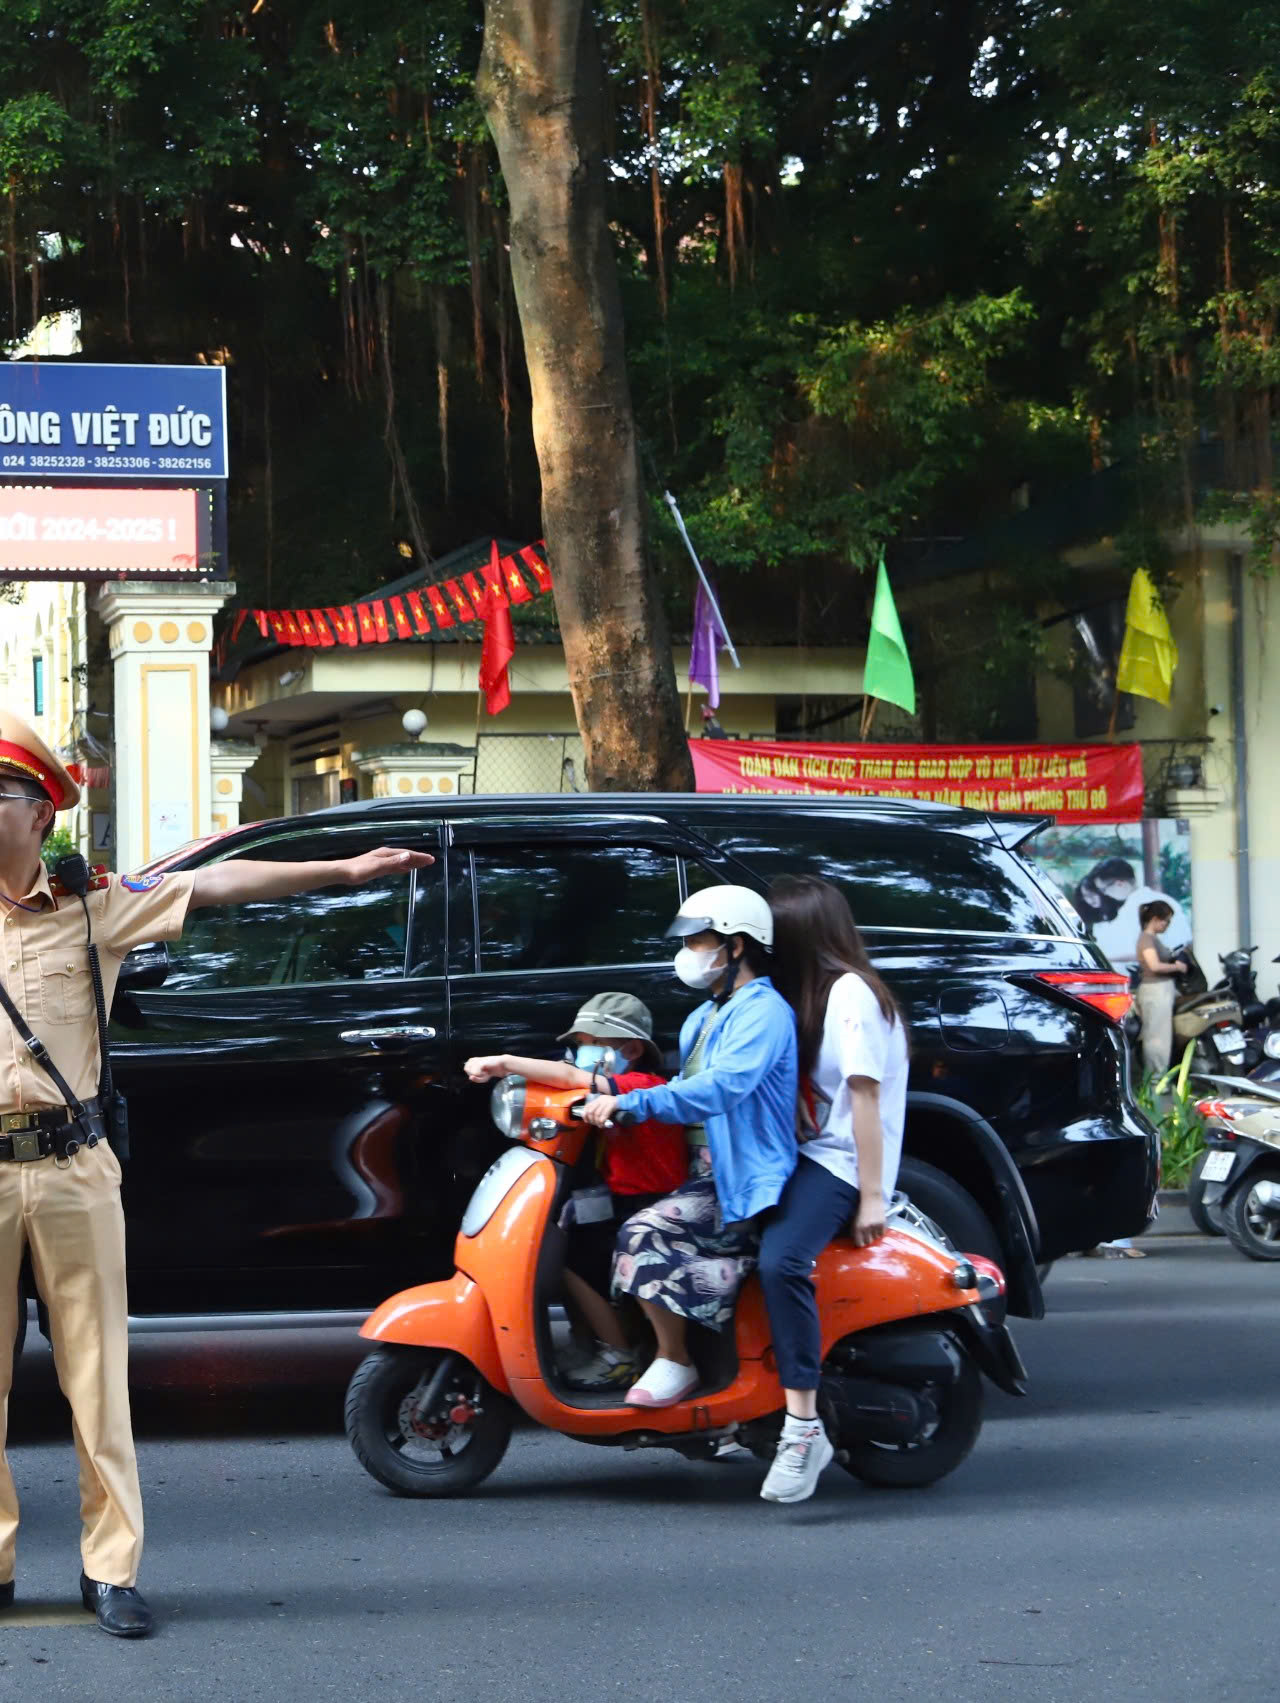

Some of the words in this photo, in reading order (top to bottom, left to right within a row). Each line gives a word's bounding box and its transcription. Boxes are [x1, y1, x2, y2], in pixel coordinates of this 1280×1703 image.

[71, 405, 139, 451] VIỆT
[148, 405, 212, 447] ĐỨC
[3, 456, 25, 467] 024
[30, 456, 85, 467] 38252328
[94, 457, 150, 468] 38253306
[158, 457, 212, 469] 38262156
[41, 517, 162, 542] 2024-2025
[739, 753, 771, 777] TOÀN
[802, 754, 829, 778] TÍCH
[831, 757, 856, 782] CỰC
[860, 759, 893, 778] THAM
[895, 759, 915, 778] GIA
[918, 759, 946, 778] GIAO
[948, 755, 973, 783] NỘP
[1019, 754, 1040, 782] VẬT
[964, 787, 995, 810] NGÀY
[1023, 786, 1064, 810] PHÓNG
[1066, 782, 1088, 810] THỦ
